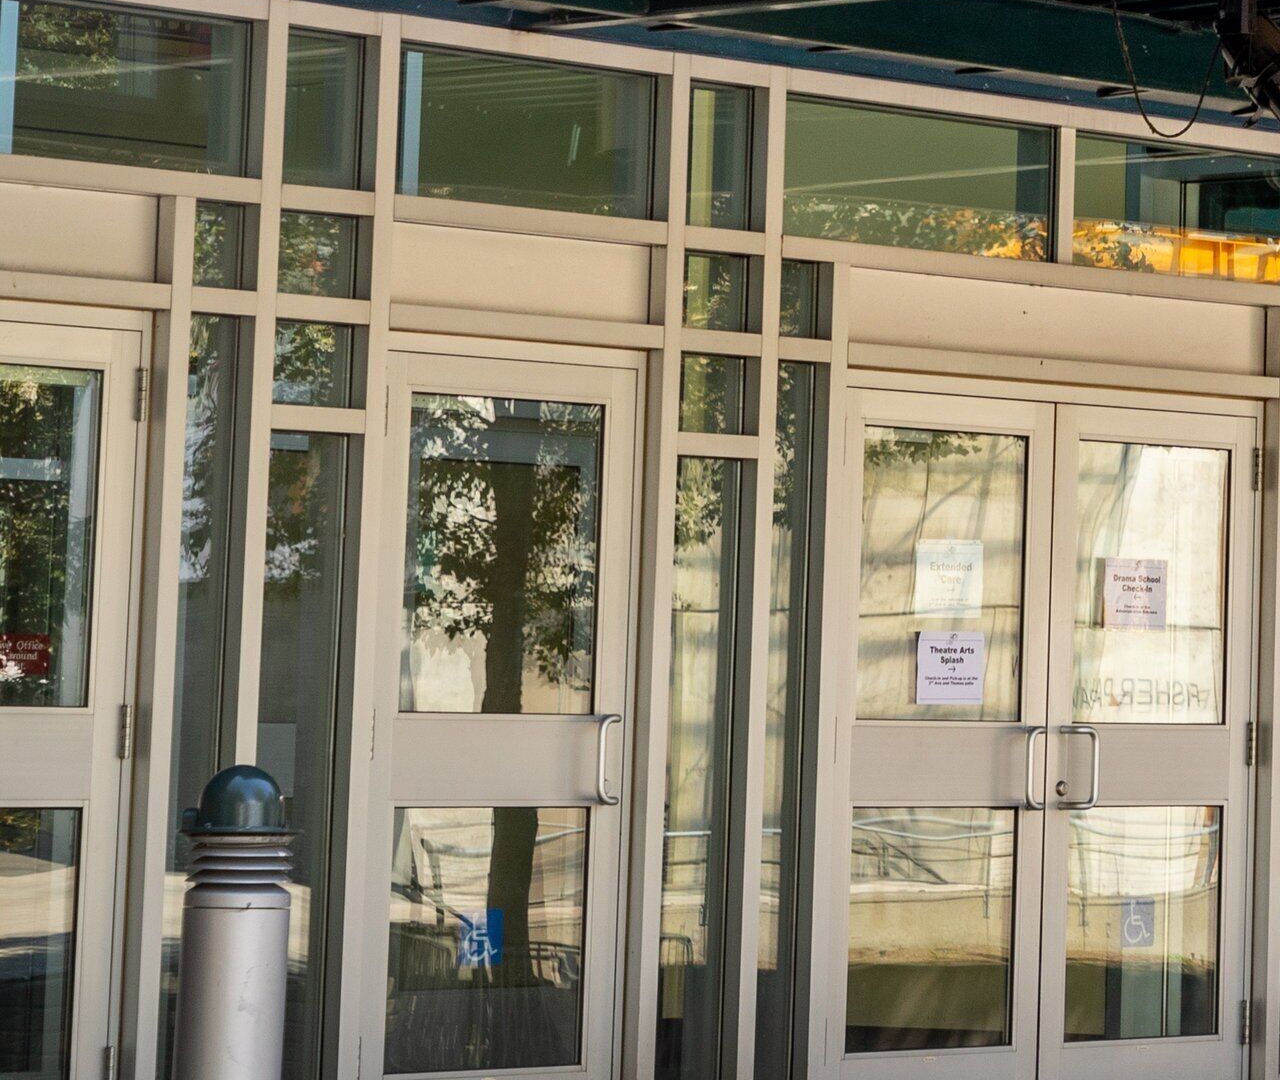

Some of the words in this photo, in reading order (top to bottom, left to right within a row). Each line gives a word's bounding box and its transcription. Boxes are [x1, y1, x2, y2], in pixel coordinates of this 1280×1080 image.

[930, 562, 973, 571] Extended
[941, 576, 961, 584] Care
[1138, 575, 1160, 583] School
[17, 640, 44, 651] Office
